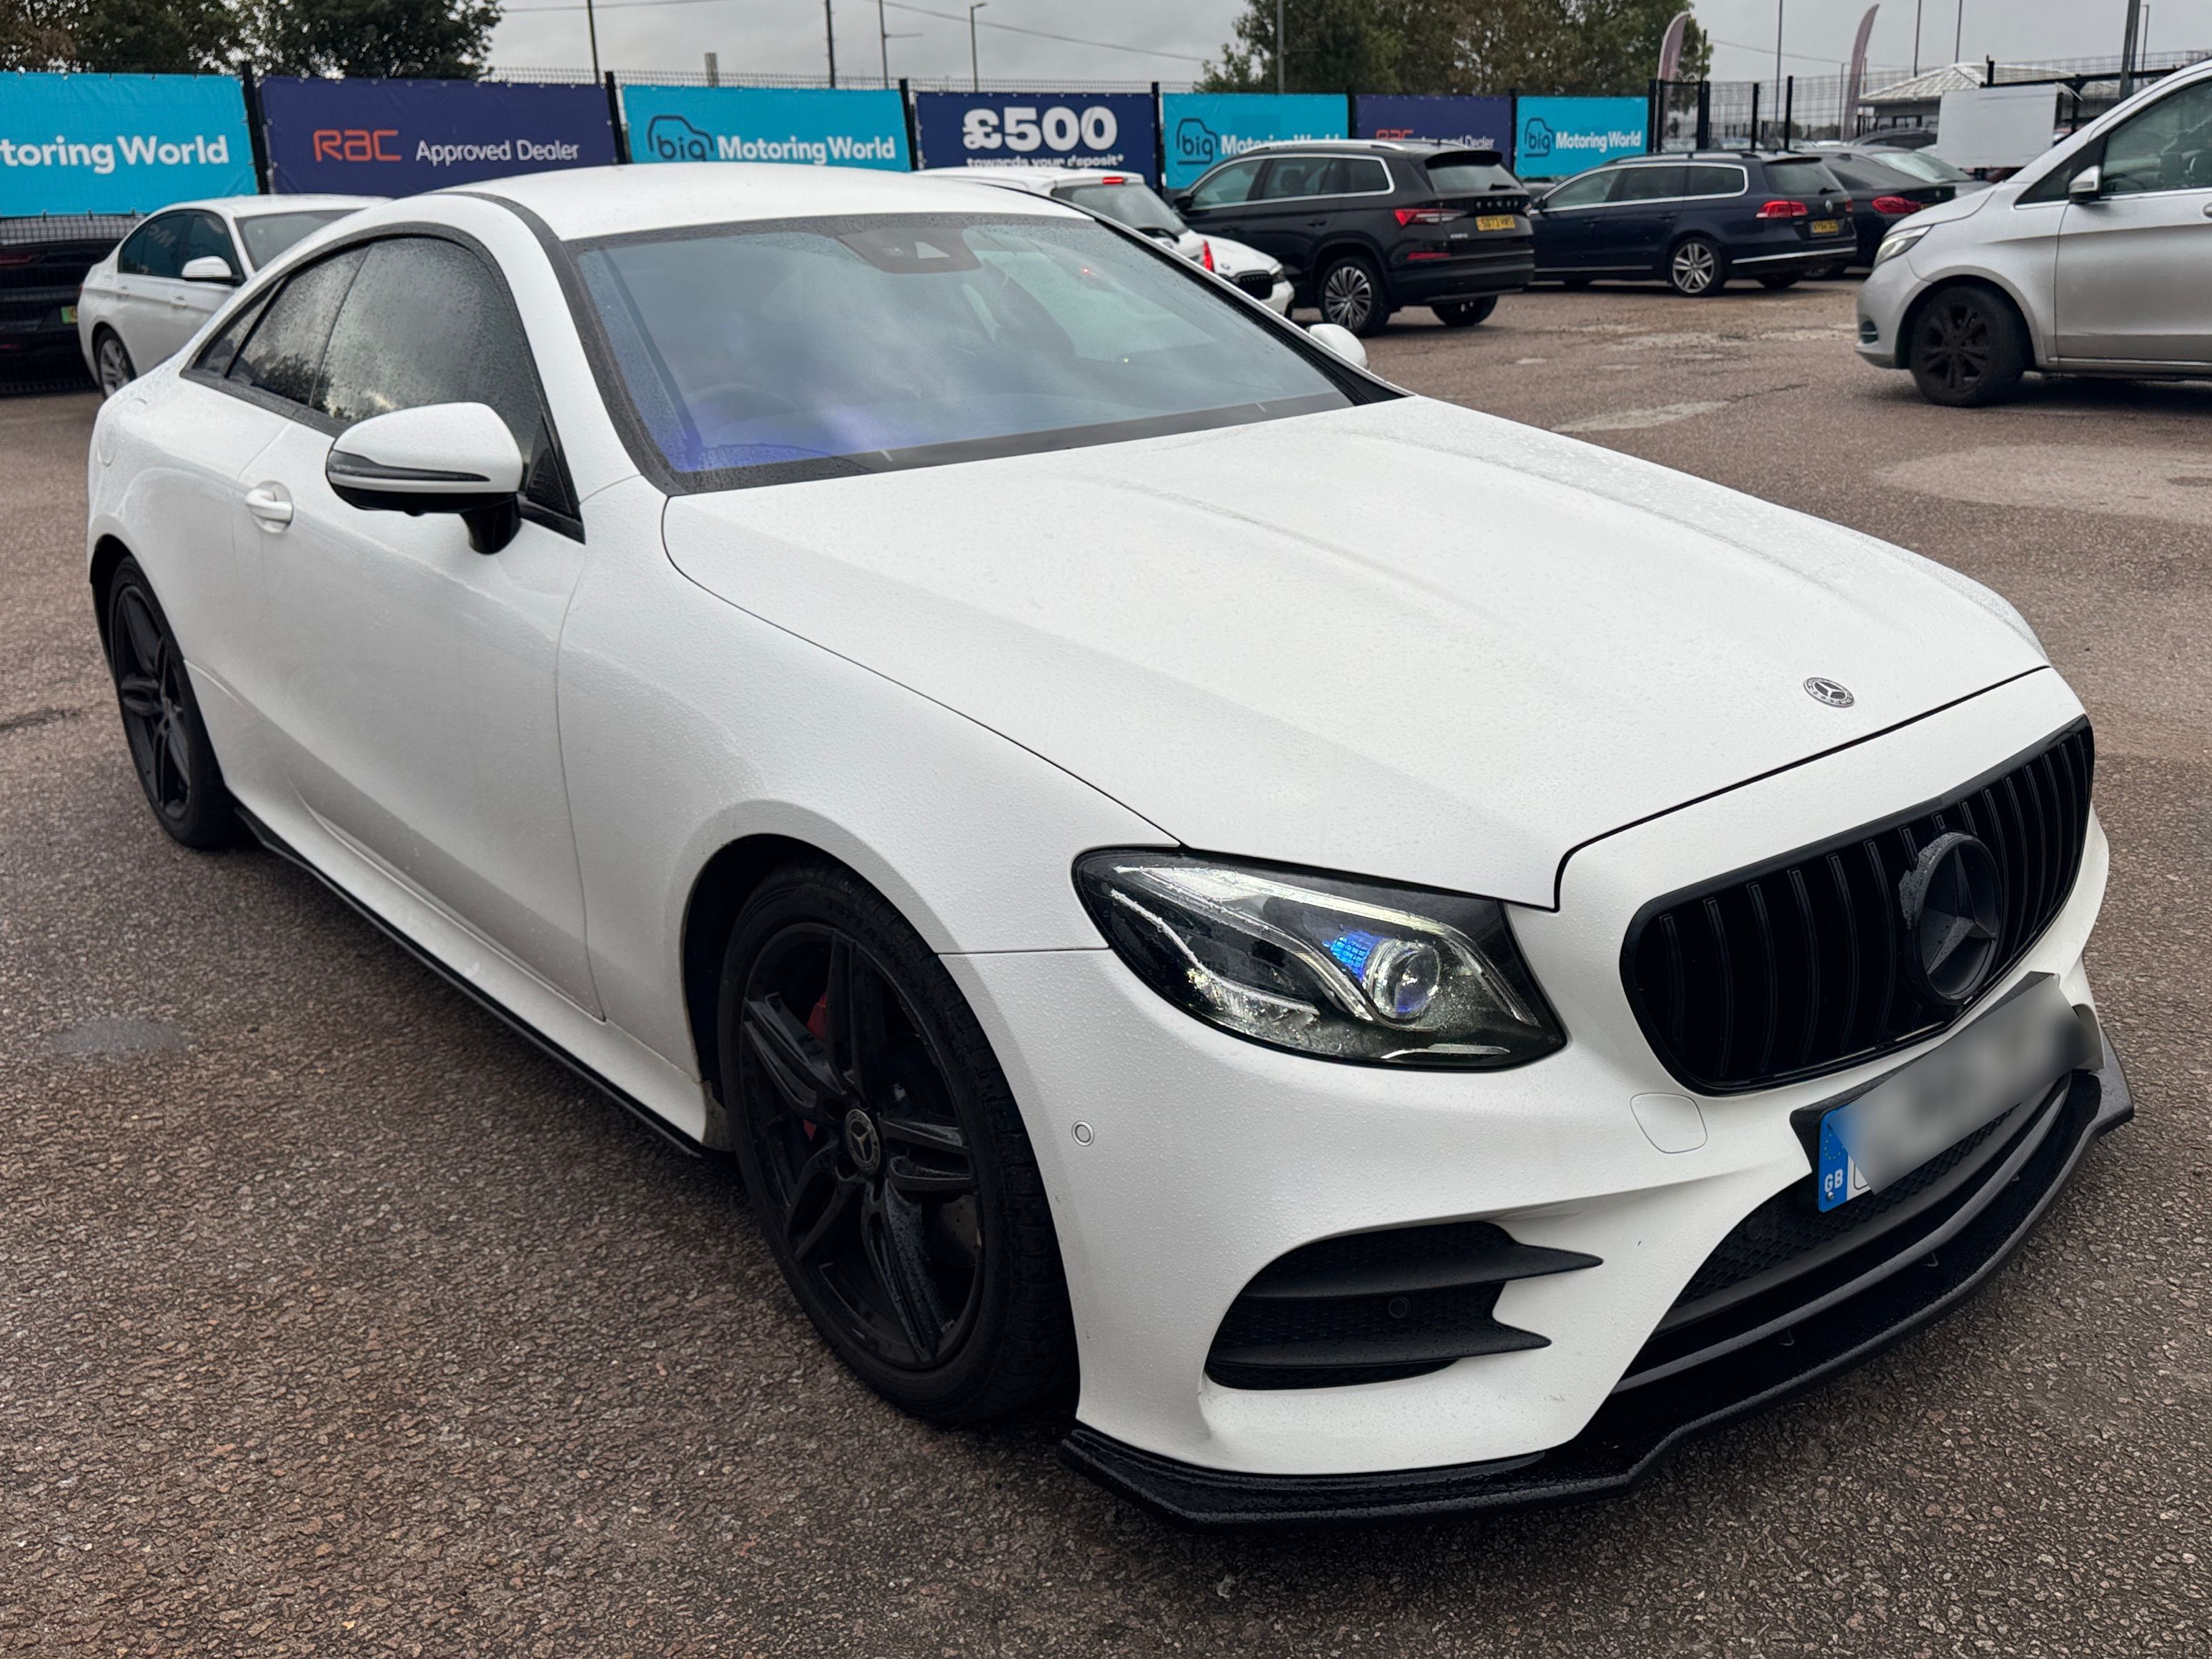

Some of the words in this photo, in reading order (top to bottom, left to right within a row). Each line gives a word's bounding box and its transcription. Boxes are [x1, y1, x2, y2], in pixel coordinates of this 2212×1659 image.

[962, 105, 1119, 152] £500
[1464, 134, 1495, 149] Dealer
[1528, 132, 1550, 156] big
[1555, 131, 1607, 154] Motoring
[1608, 129, 1642, 148] World
[0, 135, 115, 174] toring
[116, 134, 229, 165] World
[415, 139, 512, 167] Approved
[517, 139, 580, 162] Dealer
[716, 135, 827, 166] Motoring
[828, 135, 896, 160] World
[966, 155, 1030, 167] towards
[1031, 157, 1066, 167] your
[1181, 134, 1214, 164] big
[1825, 1168, 1843, 1193] GB
